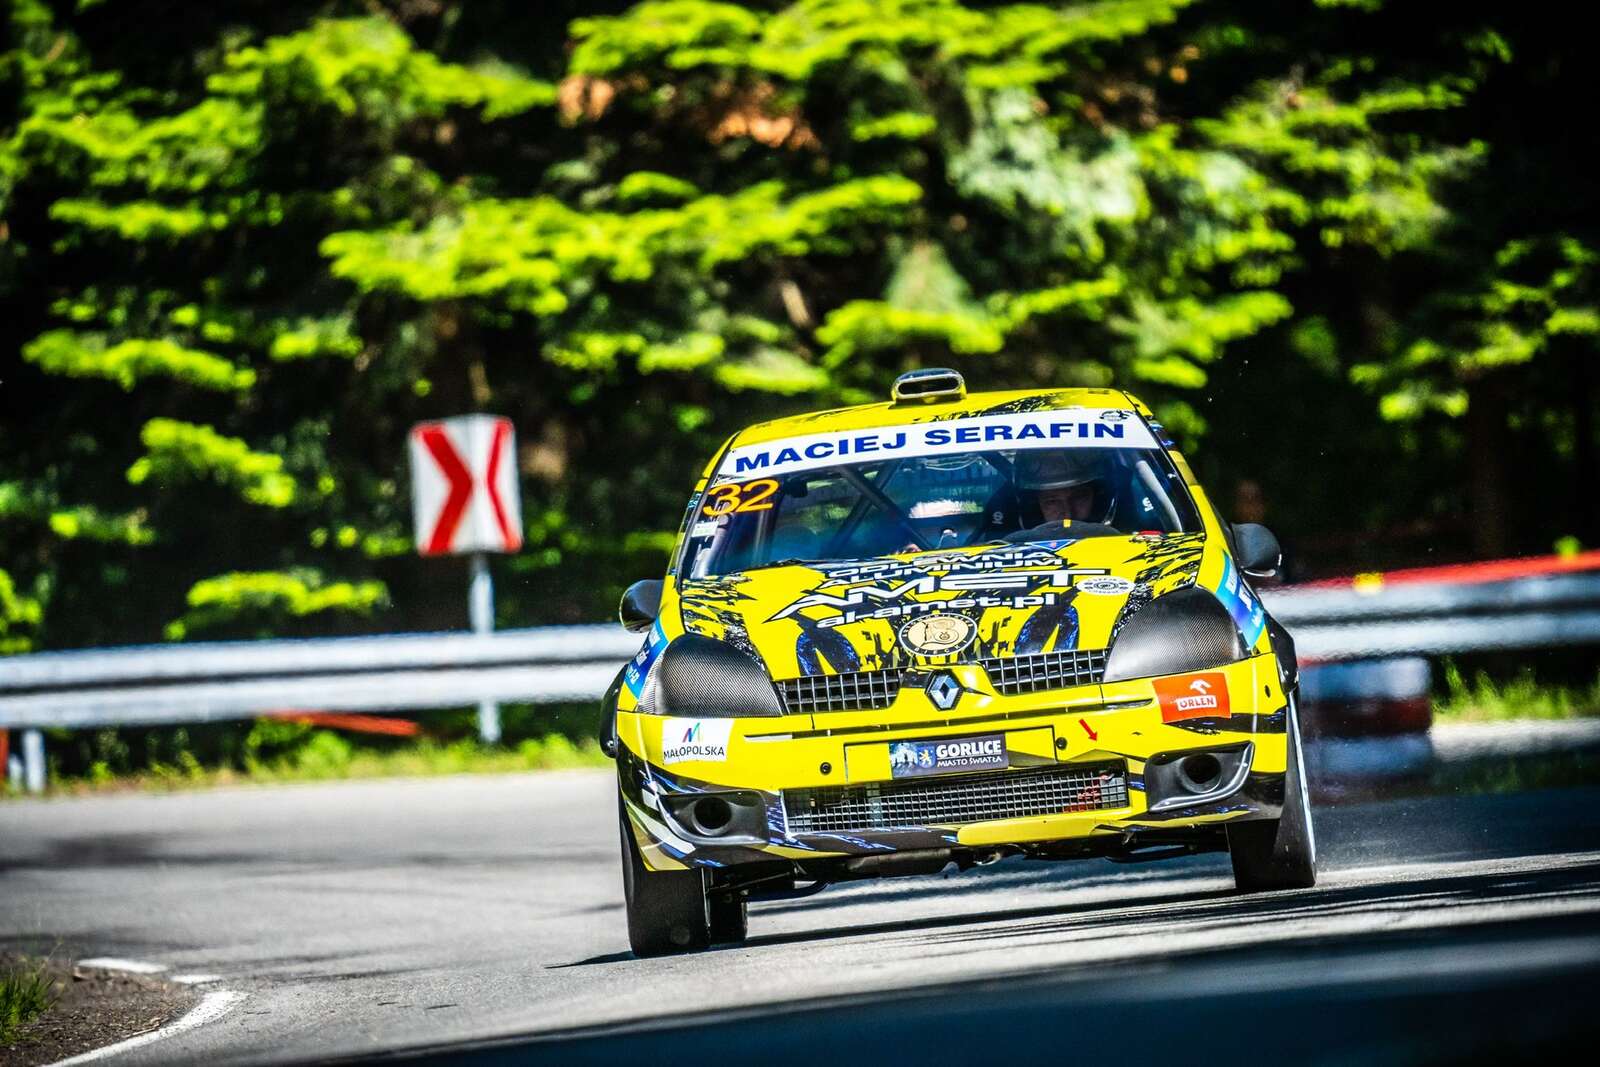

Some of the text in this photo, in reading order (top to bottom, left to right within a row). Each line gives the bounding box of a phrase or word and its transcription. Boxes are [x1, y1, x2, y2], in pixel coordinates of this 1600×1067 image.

[735, 423, 1124, 473] MACIEJ SERAFIN
[703, 479, 780, 516] 32
[818, 558, 1063, 589] ALUMINIUM
[829, 552, 1055, 578] ODLEWNIA
[816, 593, 1055, 628] al-amet.pl
[1180, 697, 1214, 708] ORLEN
[663, 746, 725, 759] MAŁOPOLSKA
[936, 740, 1001, 757] GORLICE
[937, 758, 967, 767] MIASTO
